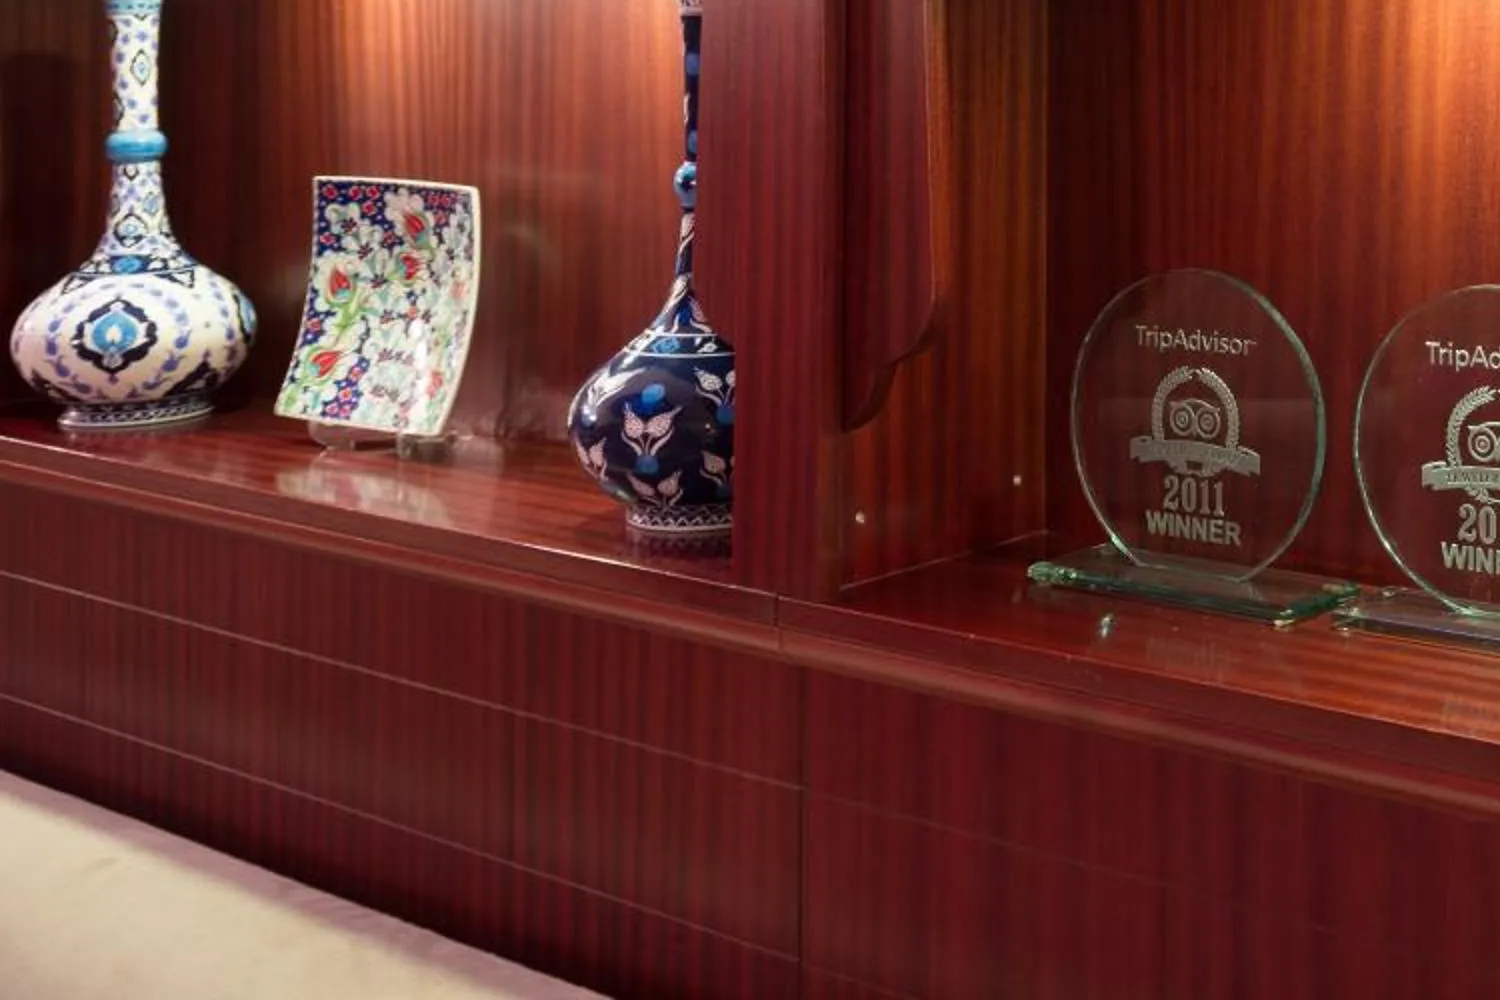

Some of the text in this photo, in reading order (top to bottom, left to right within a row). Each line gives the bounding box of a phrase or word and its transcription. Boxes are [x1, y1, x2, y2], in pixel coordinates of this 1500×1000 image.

[1135, 324, 1253, 356] TripAdvisor
[1163, 475, 1226, 517] 2011
[1146, 509, 1242, 546] WINNER
